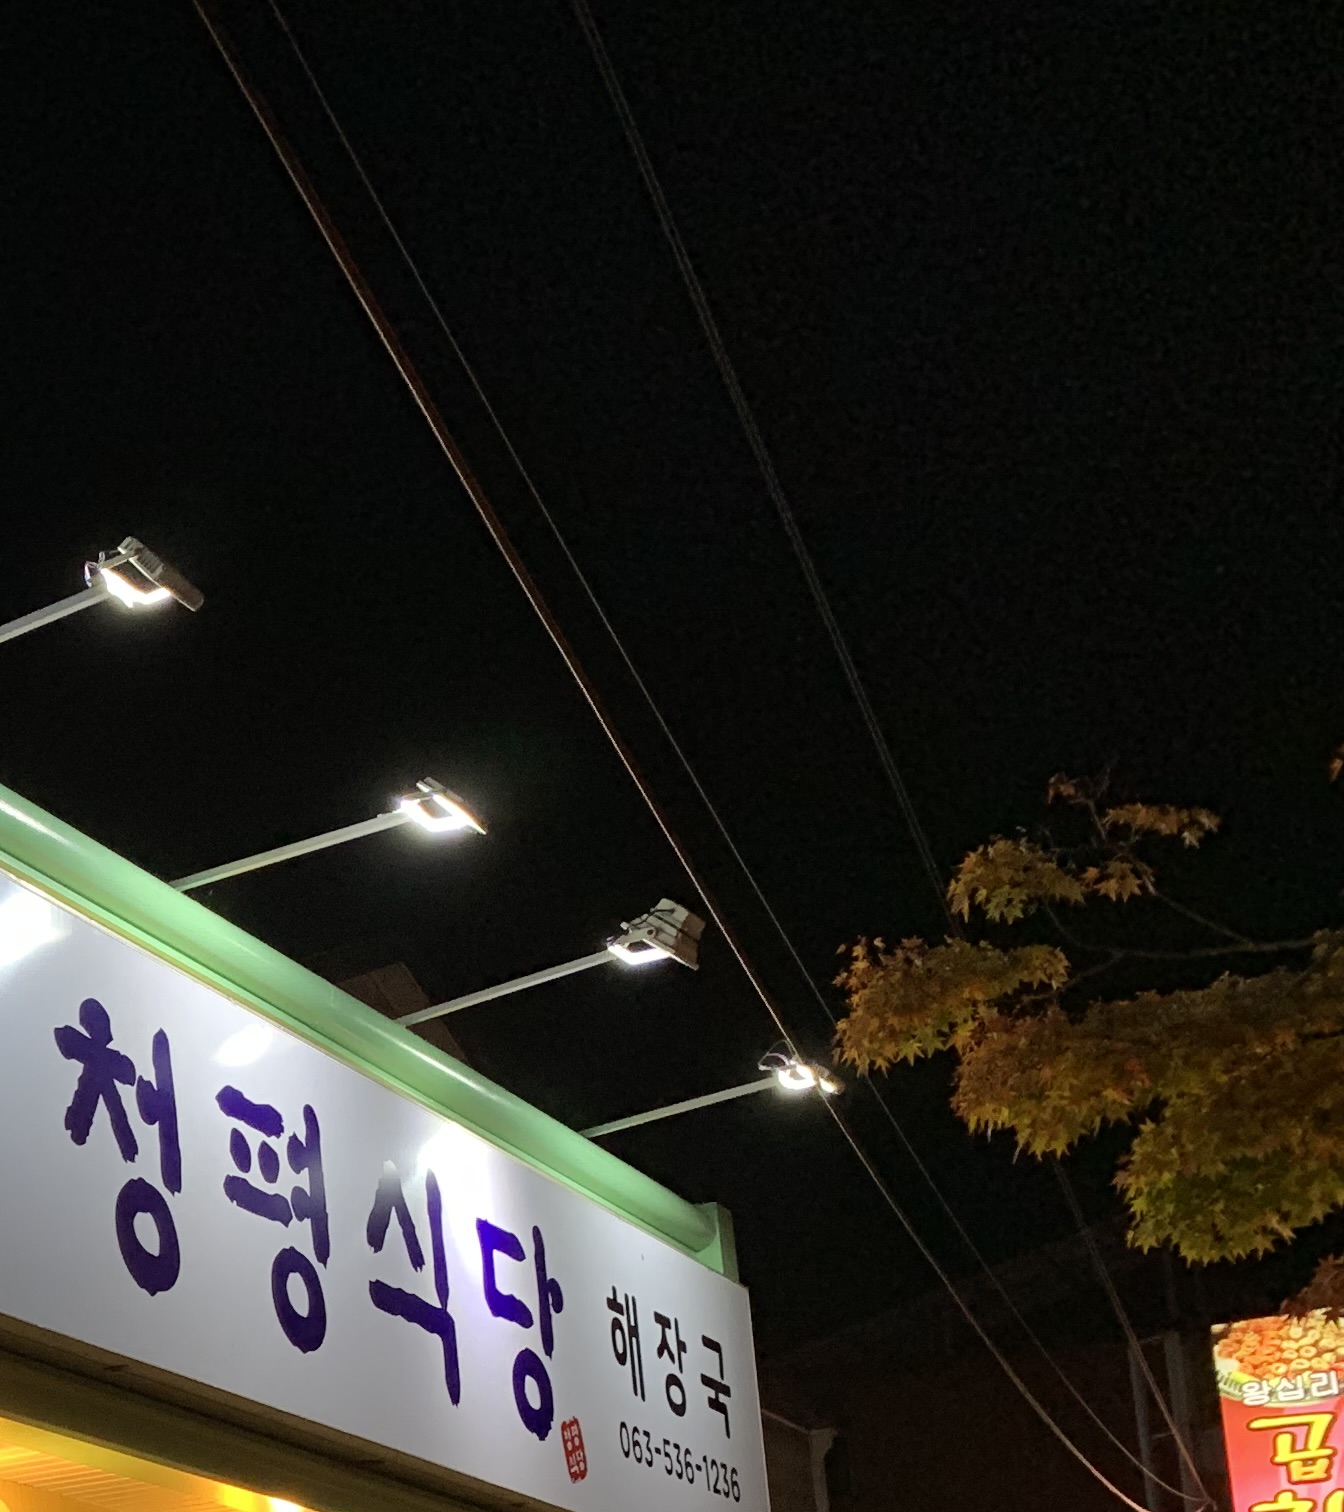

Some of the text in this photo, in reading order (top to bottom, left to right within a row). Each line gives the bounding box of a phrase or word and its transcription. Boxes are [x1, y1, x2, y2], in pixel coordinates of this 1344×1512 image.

[54, 998, 564, 1441] 청평식당
[607, 1286, 732, 1439] 해장국
[1241, 1370, 1339, 1406] 왕십리
[620, 1422, 742, 1503] 063-536-1236
